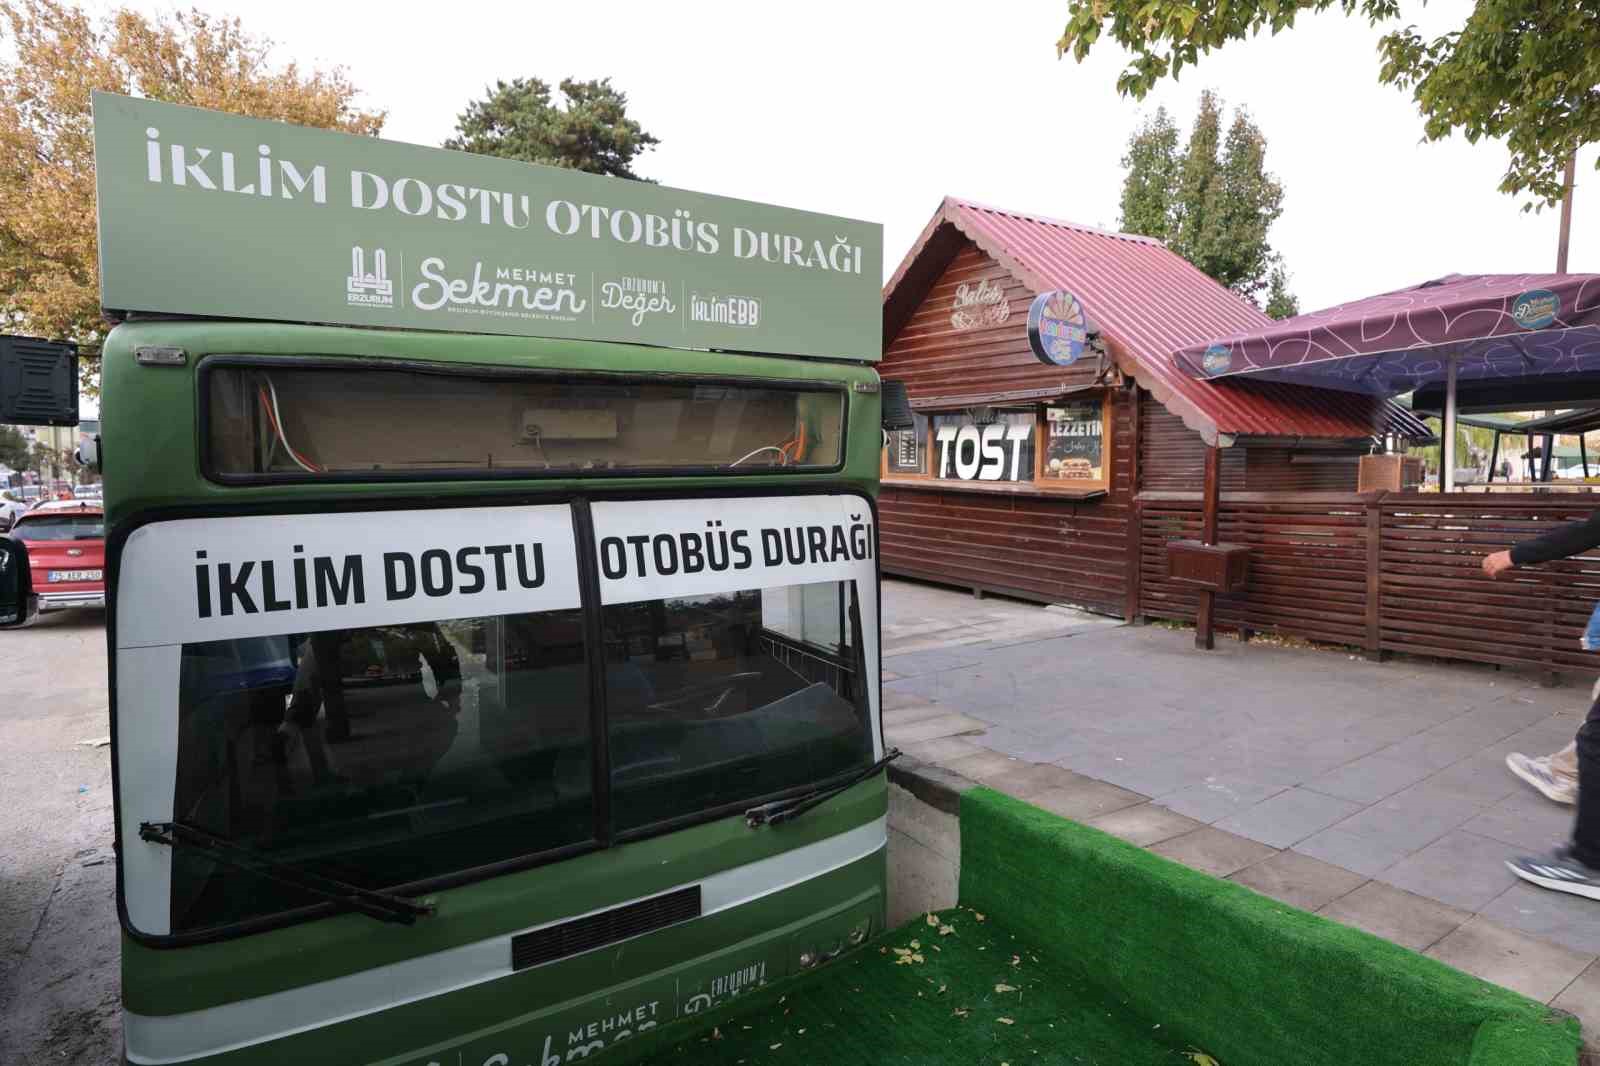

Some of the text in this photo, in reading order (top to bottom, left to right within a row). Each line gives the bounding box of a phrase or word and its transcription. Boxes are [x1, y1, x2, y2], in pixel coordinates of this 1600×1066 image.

[146, 127, 862, 275] İKLİM DOSTU OTOBÜS DURAĞI
[347, 293, 393, 305] ERZURUM
[412, 257, 586, 313] Sekmen
[496, 266, 576, 285] MEHMET
[601, 282, 677, 327] Değer
[936, 424, 1031, 481] TOST
[195, 513, 873, 618] İKLİM DOSTU OTOBÜS DURAĞI
[568, 1001, 659, 1045] MEHMET
